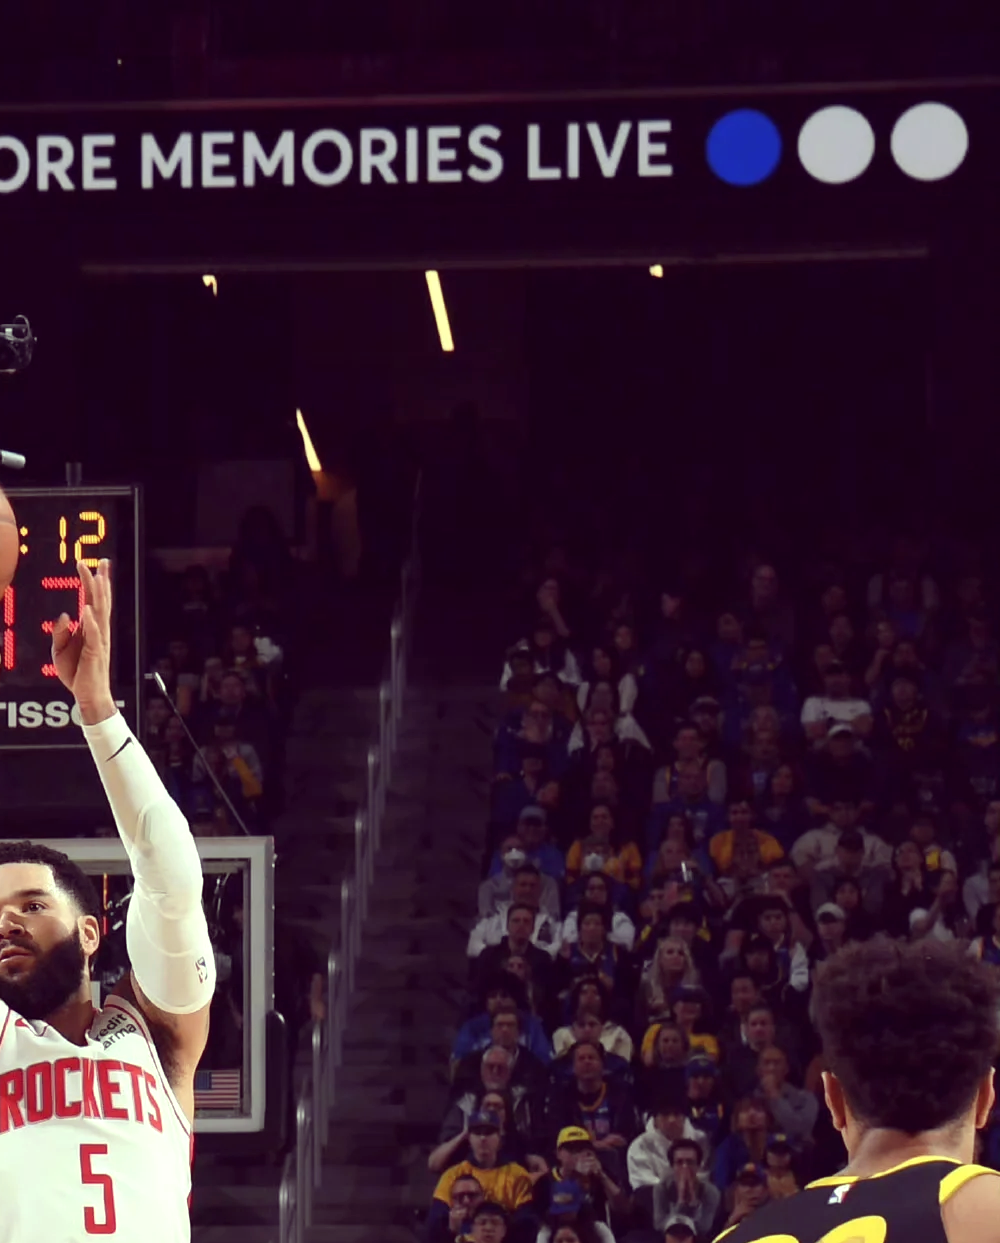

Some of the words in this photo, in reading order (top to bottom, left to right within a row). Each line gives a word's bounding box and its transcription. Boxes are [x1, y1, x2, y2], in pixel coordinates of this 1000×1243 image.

[141, 124, 504, 190] MEMORIES
[527, 120, 673, 180] LIVE
[95, 1013, 128, 1042] redit
[102, 1023, 137, 1051] arma
[79, 1143, 117, 1235] 5
